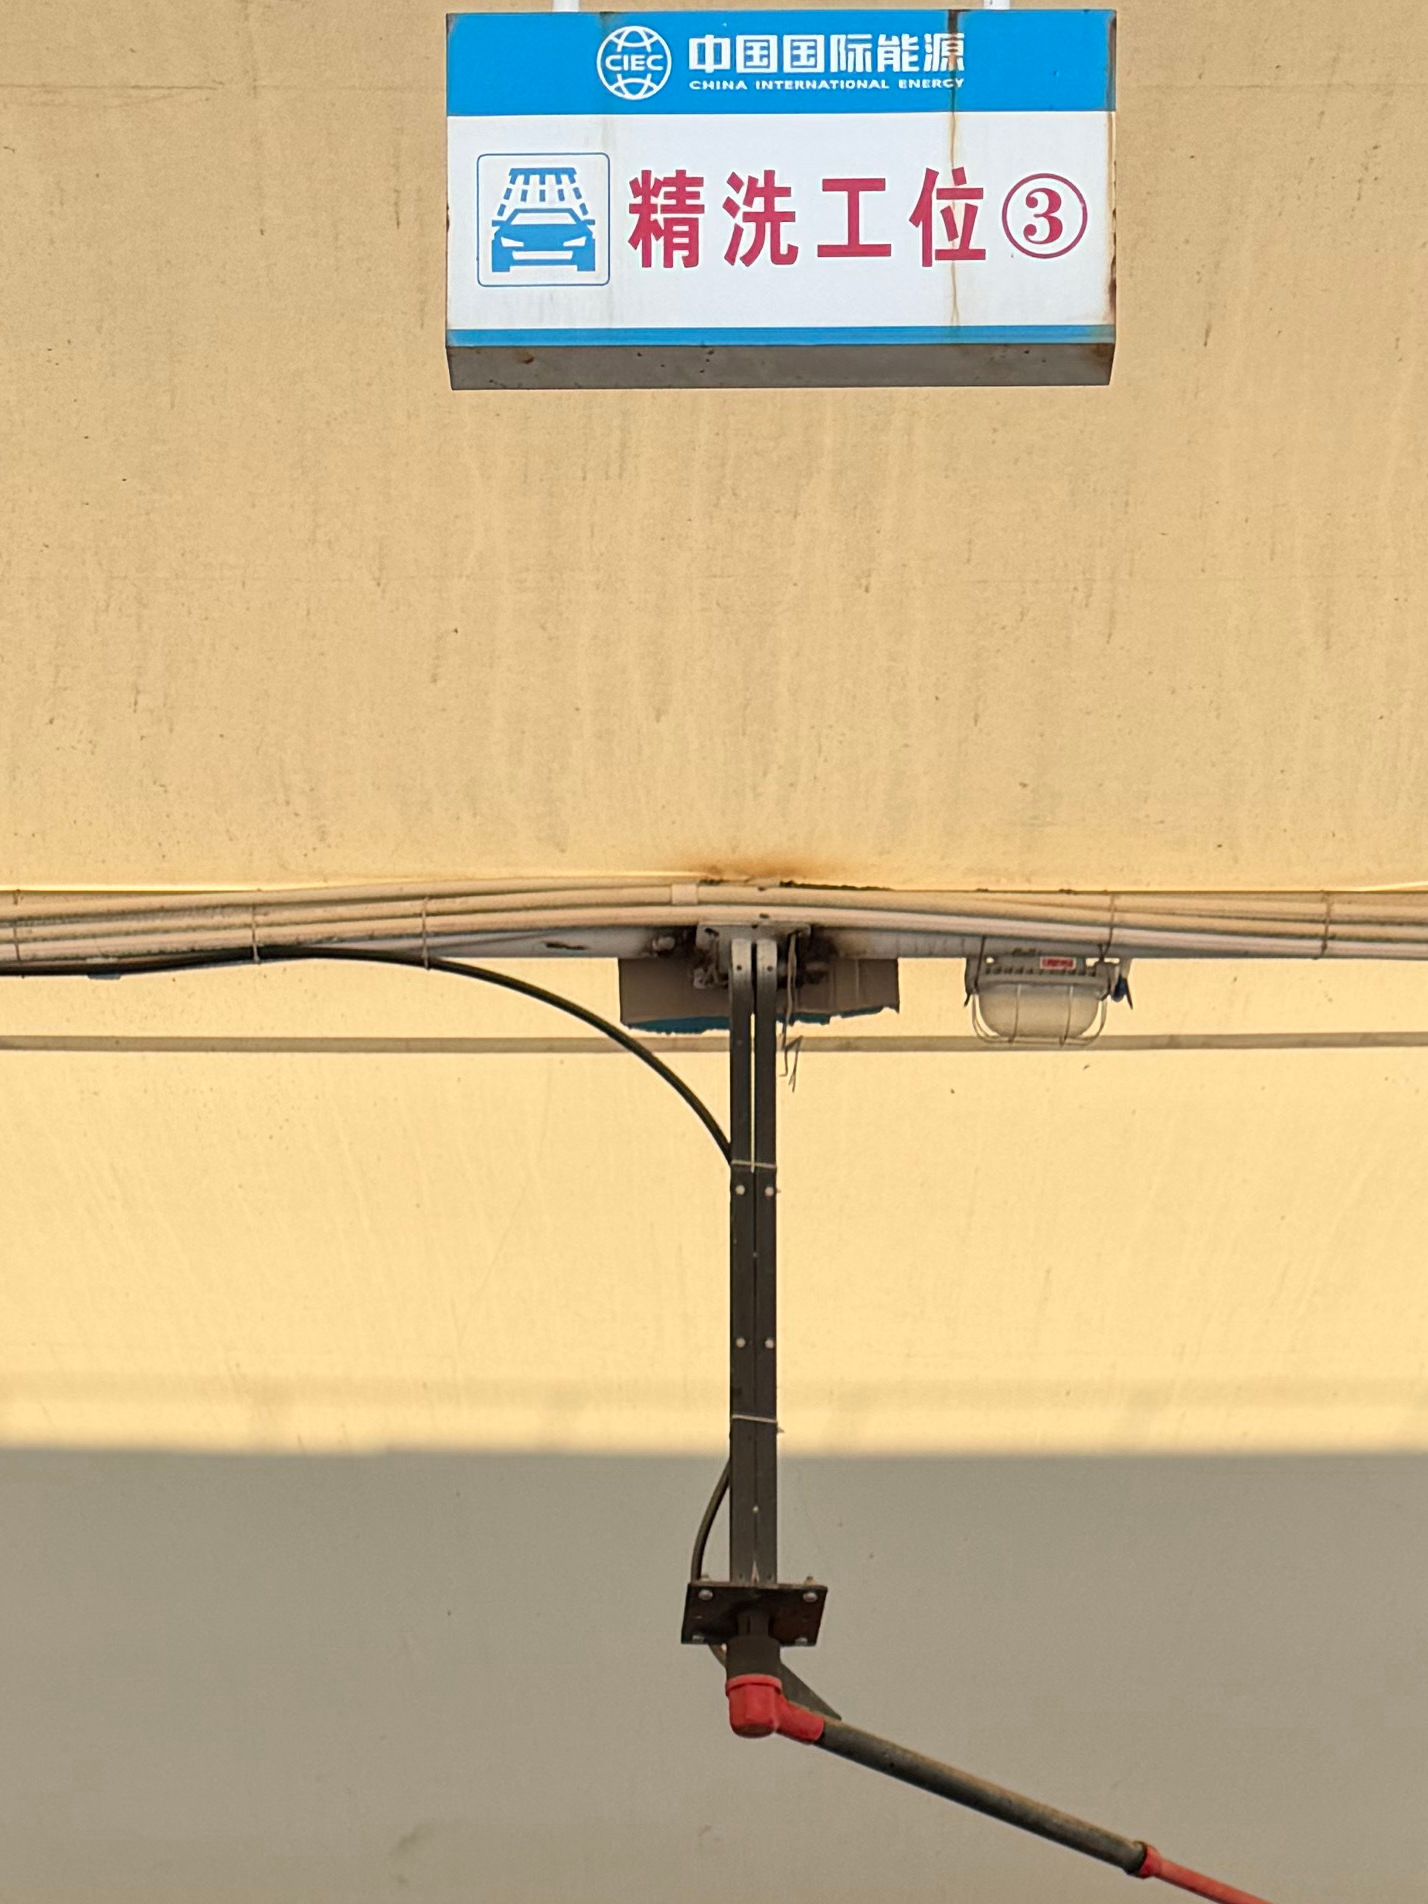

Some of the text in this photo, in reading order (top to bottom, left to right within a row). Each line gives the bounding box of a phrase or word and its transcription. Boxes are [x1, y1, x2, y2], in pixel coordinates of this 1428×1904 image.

[688, 33, 965, 74] 中国国际能源
[605, 54, 664, 71] CIEC
[689, 78, 965, 90] CHINA INTERNATIONAL ENERGY
